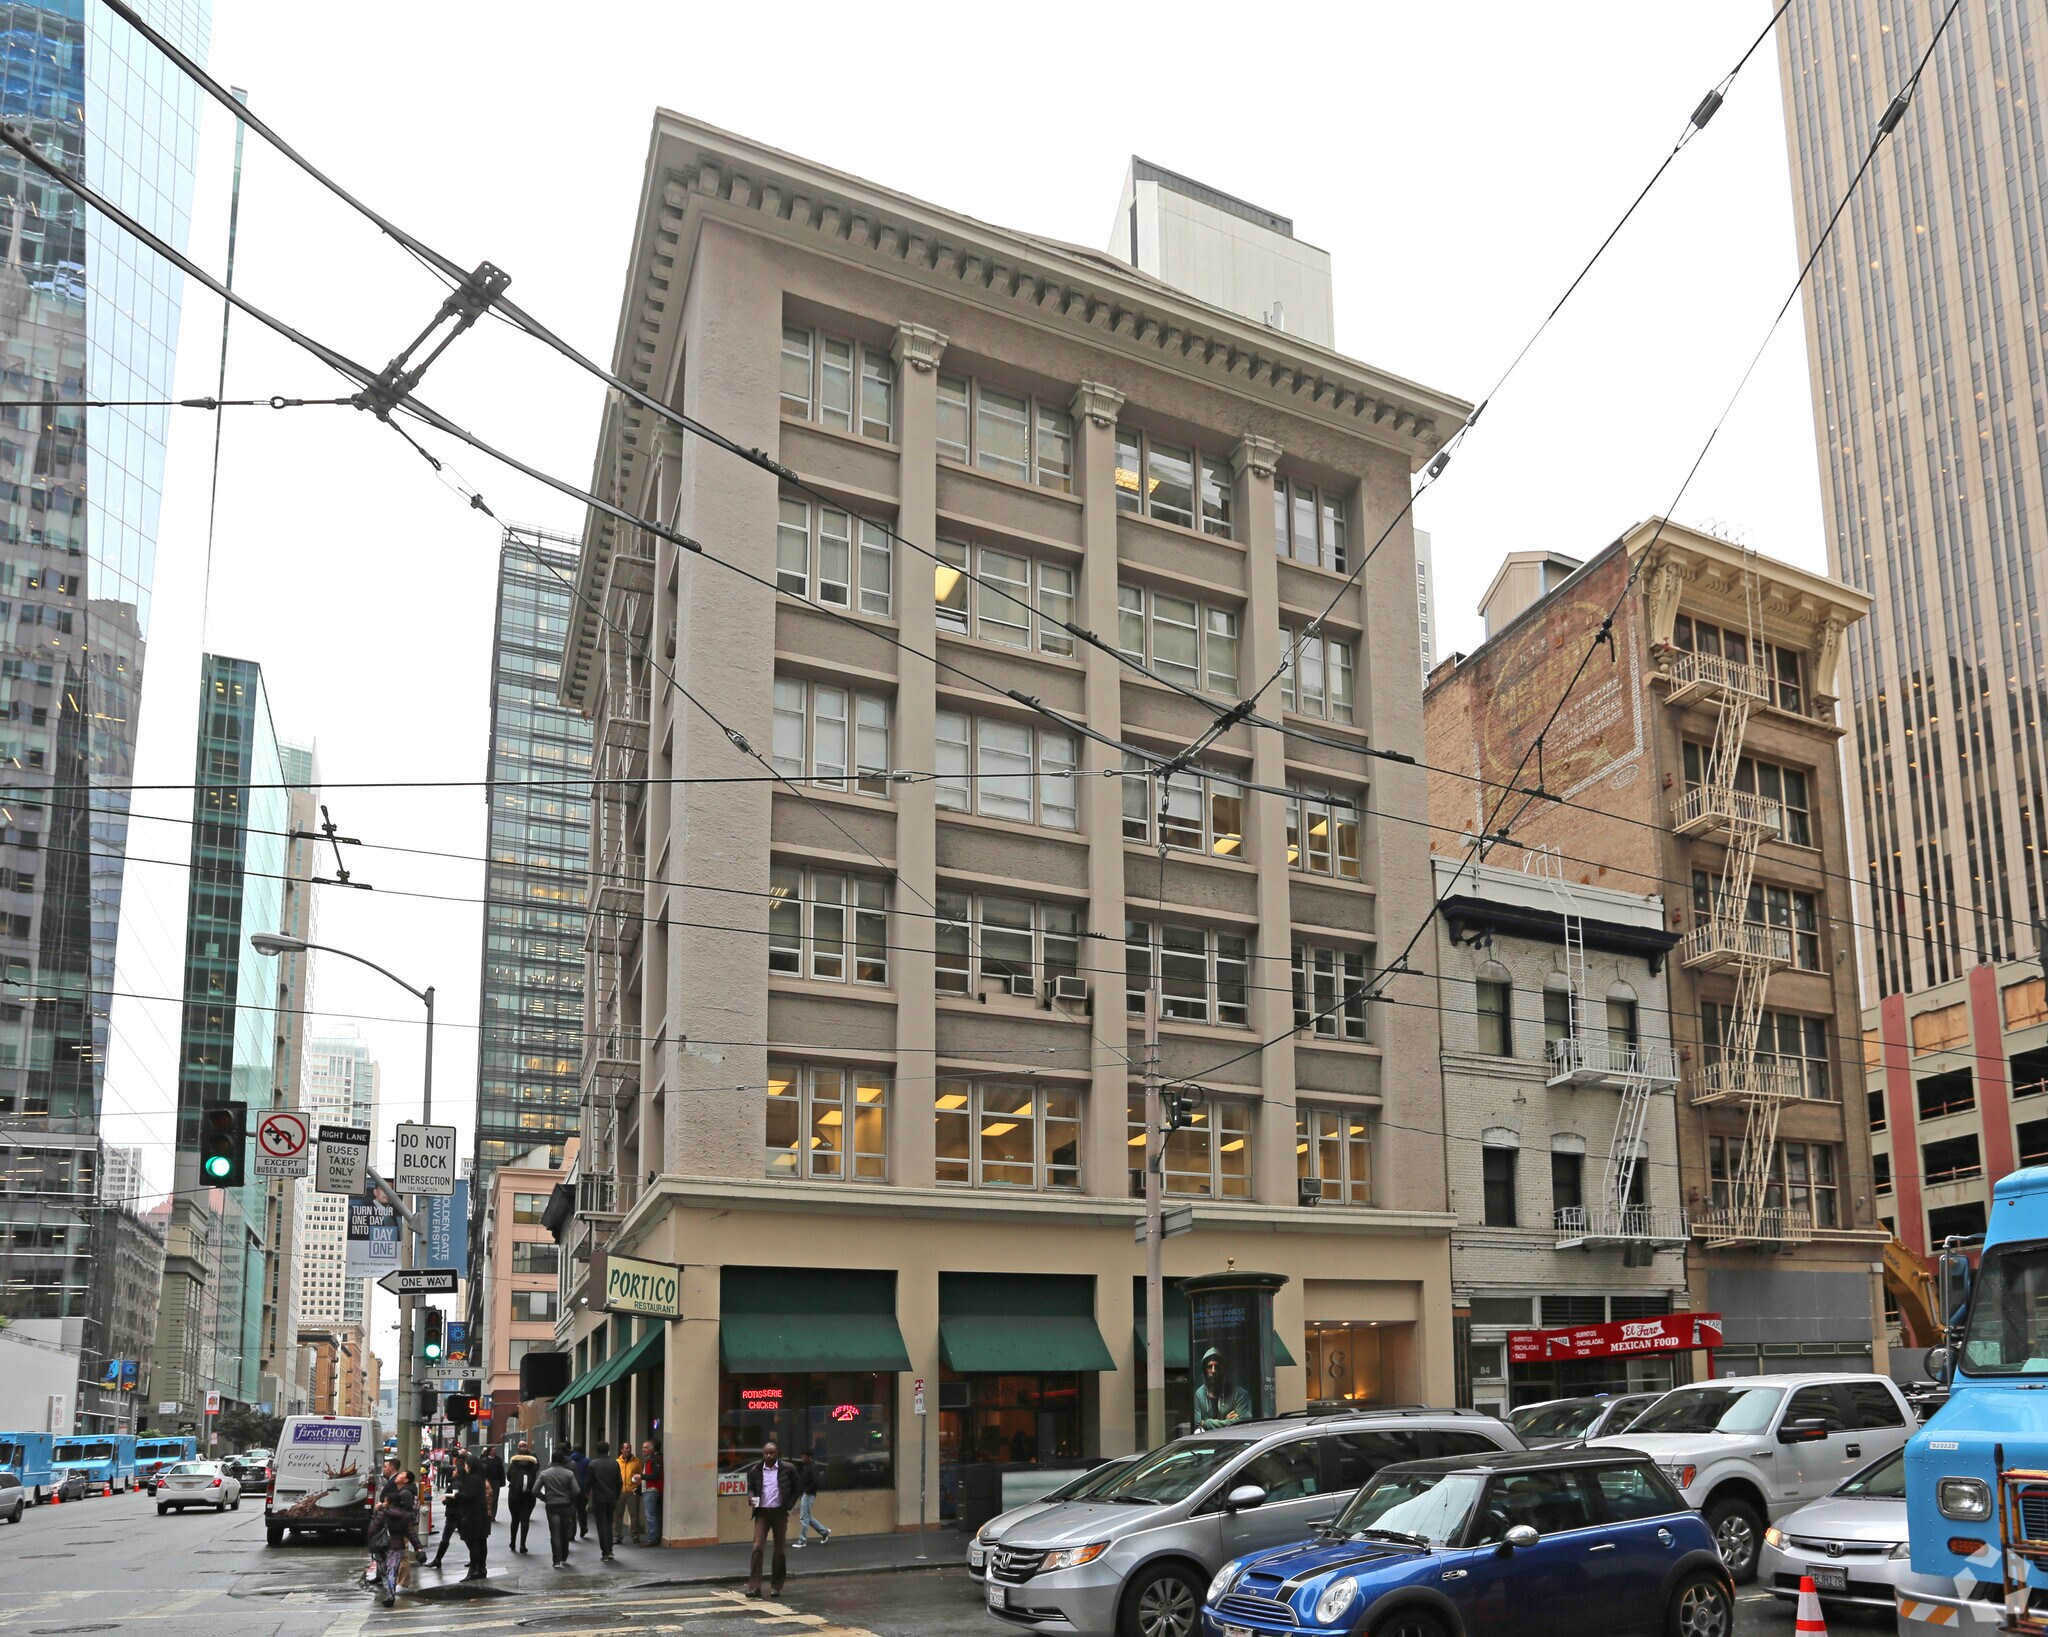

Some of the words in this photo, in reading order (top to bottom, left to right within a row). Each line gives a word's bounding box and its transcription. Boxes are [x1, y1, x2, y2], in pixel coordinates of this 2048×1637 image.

[321, 1130, 344, 1139] RIGHT
[346, 1133, 367, 1142] LANE
[401, 1134, 418, 1148] DO
[426, 1135, 451, 1150] NOT
[326, 1145, 359, 1156] BUSES
[264, 1158, 299, 1167] EXCEPT
[329, 1156, 356, 1166] TAXIS
[404, 1154, 447, 1169] BLOCK
[256, 1166, 278, 1174] BUSES
[329, 1166, 354, 1177] ONLY
[399, 1175, 451, 1186] INTERSECTION
[352, 1206, 372, 1216] TURN
[373, 1206, 394, 1216] YOUR
[352, 1215, 367, 1225] ONE
[369, 1216, 385, 1226] DAY
[352, 1225, 369, 1235] INTO
[373, 1228, 393, 1241] DAY
[373, 1242, 393, 1255] ONE
[441, 1233, 450, 1261] GATE
[401, 1278, 423, 1287] ONE
[427, 1277, 448, 1286] WAY
[609, 1268, 676, 1304] PORTICO
[634, 1301, 675, 1314] RESTAURANT
[1576, 1330, 1597, 1338] BURRITOS
[1626, 1325, 1634, 1336] El
[1637, 1325, 1659, 1337] Faro
[1576, 1338, 1604, 1347] ENCHILADAS
[1610, 1338, 1652, 1352] MEXICAN
[1654, 1336, 1680, 1348] FOOD
[436, 1369, 452, 1377] 1ST
[1480, 1366, 1490, 1375] 84
[742, 1389, 782, 1399] ROTISSERIE
[469, 1400, 477, 1415] 9
[748, 1401, 779, 1410] CHICKEN
[843, 1405, 860, 1416] PIZZA
[288, 1452, 315, 1460] Coffee
[719, 1481, 746, 1494] OPEN
[1811, 1573, 1843, 1586] BJH178
